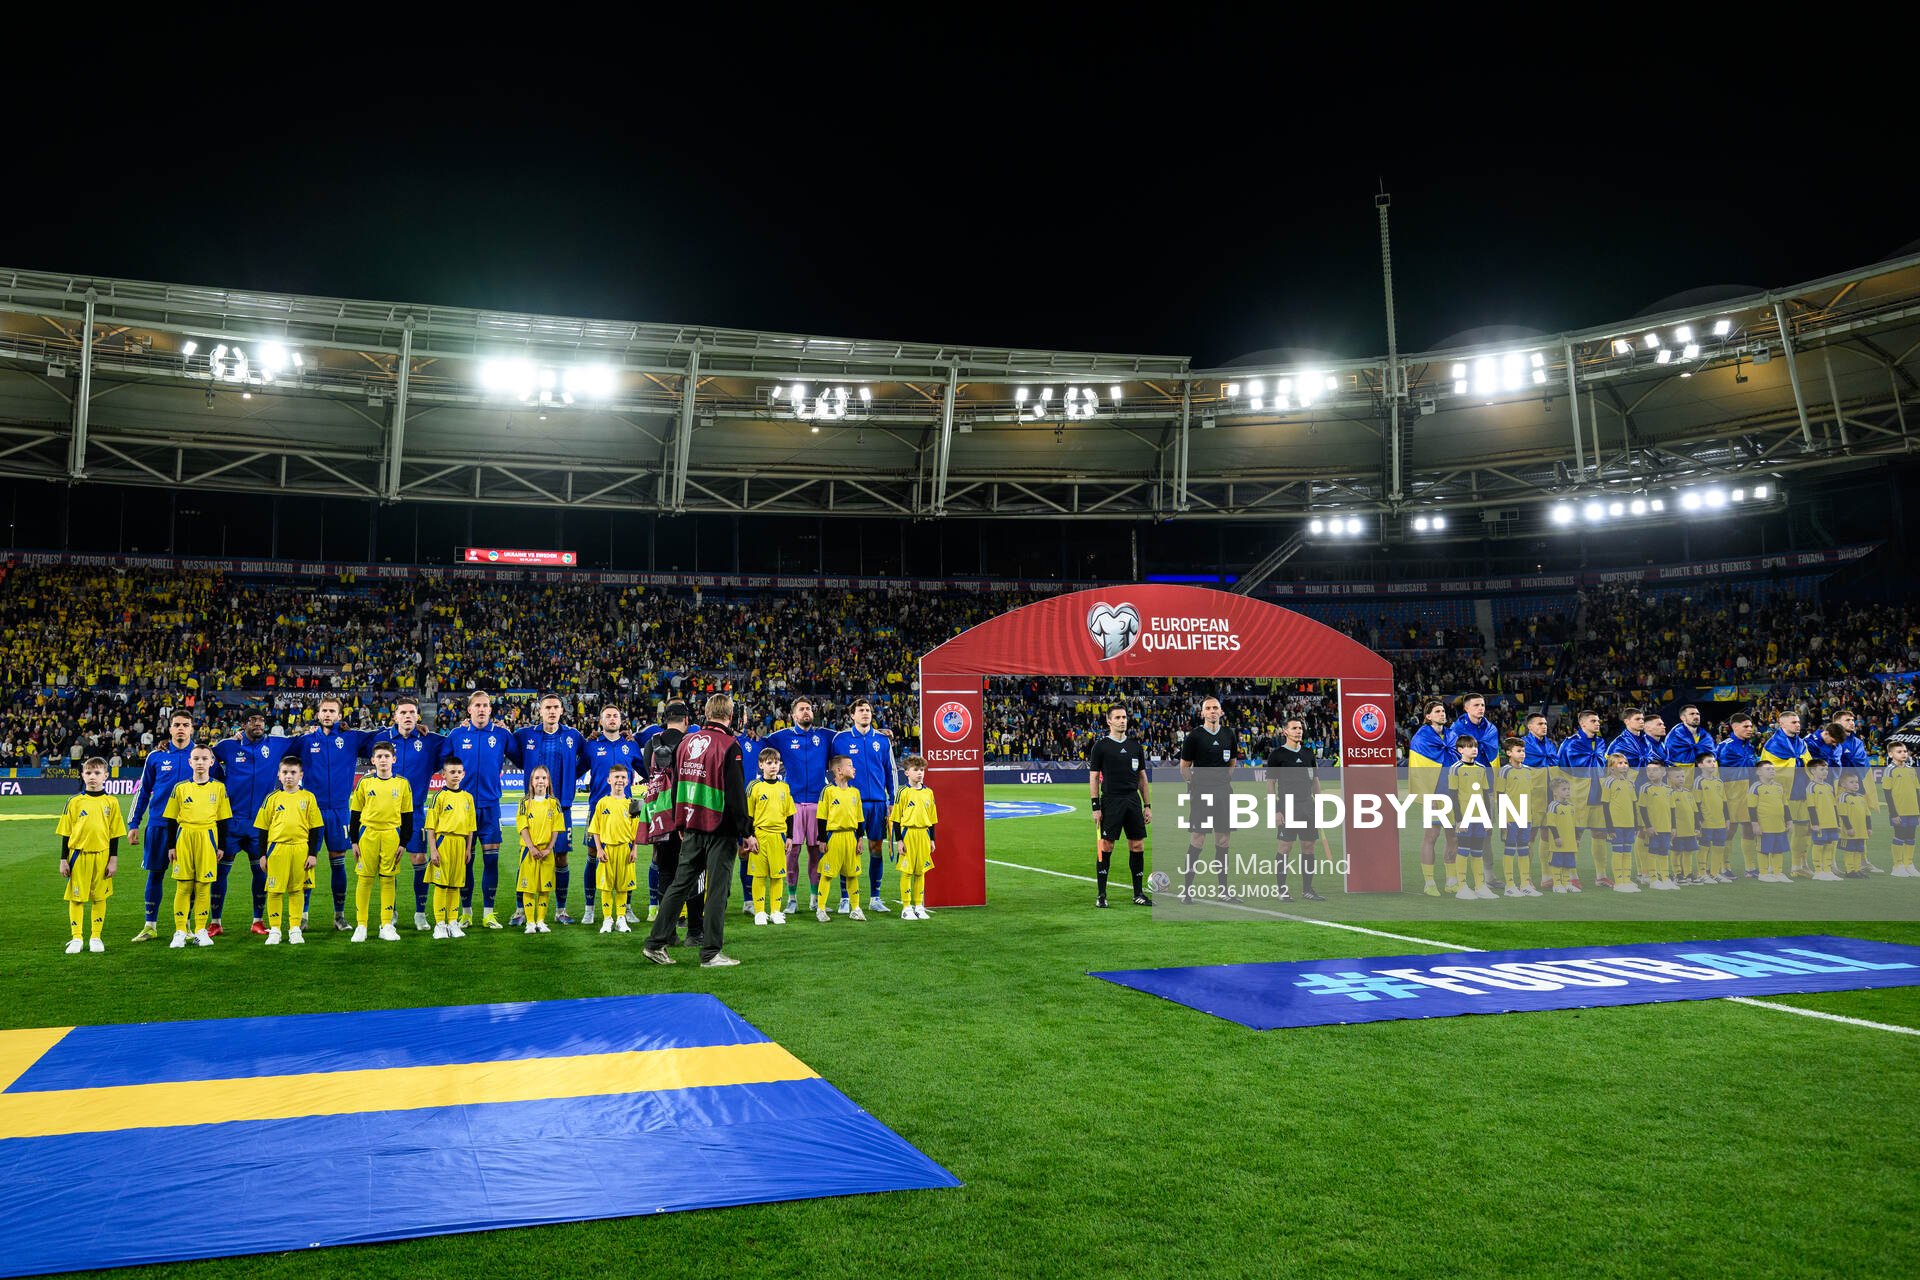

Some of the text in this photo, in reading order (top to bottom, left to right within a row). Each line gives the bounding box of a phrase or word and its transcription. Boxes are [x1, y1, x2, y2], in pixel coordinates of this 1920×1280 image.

[240, 561, 262, 573] CHIVA
[1151, 617, 1229, 633] EUROPEAN
[1141, 632, 1241, 653] QUALIFIERS
[941, 704, 963, 714] UEFA
[927, 749, 979, 761] RESPECT
[1347, 747, 1393, 758] RESPECT
[1020, 772, 1053, 784] UEFA
[0, 782, 22, 795] FA
[1294, 947, 1918, 1002] #FOOTBALL
